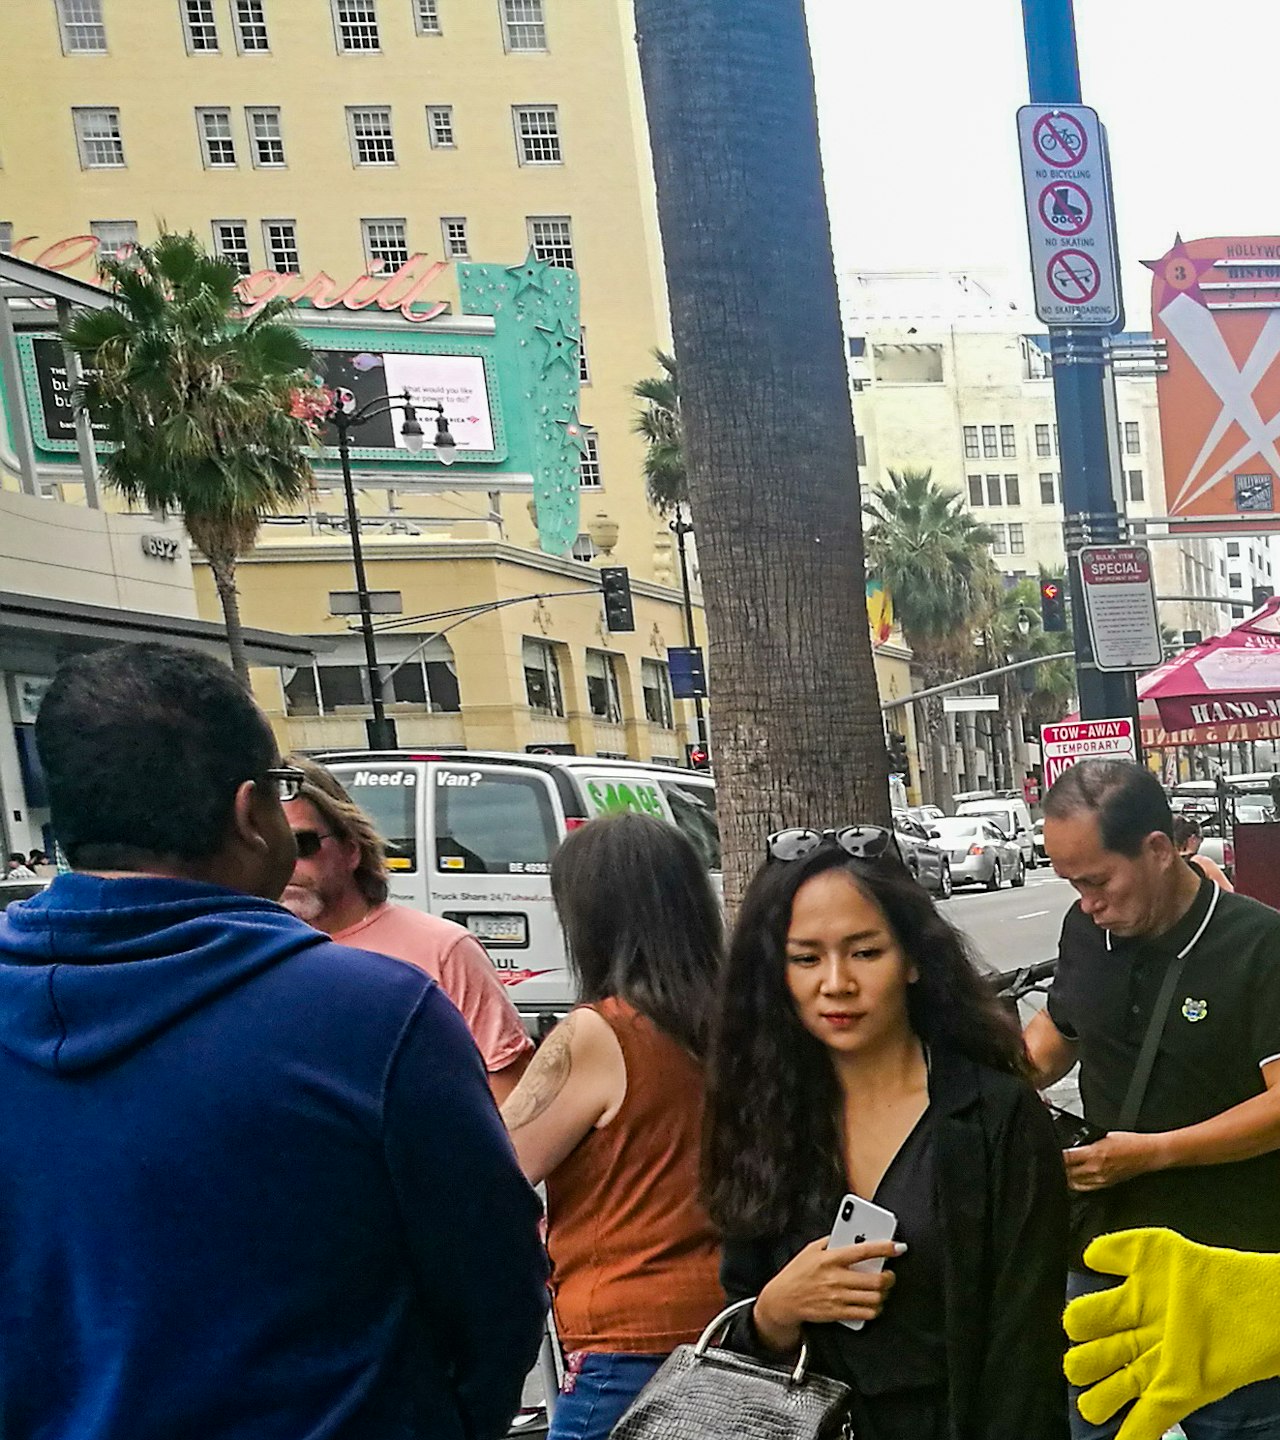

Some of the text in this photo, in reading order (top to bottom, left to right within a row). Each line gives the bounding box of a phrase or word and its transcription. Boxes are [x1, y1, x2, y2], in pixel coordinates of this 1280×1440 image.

[1036, 170, 1091, 179] NO BICYCLING
[1045, 238, 1095, 247] NO SKATING
[1174, 266, 1187, 281] 3
[1042, 306, 1052, 314] NO
[1091, 562, 1142, 575] SPECIAL
[1051, 722, 1121, 741] TOW-AWAY
[1056, 740, 1120, 754] TEMPORARY
[354, 771, 482, 788] Need a Van?
[432, 892, 457, 902] Truck
[460, 892, 488, 902] Share
